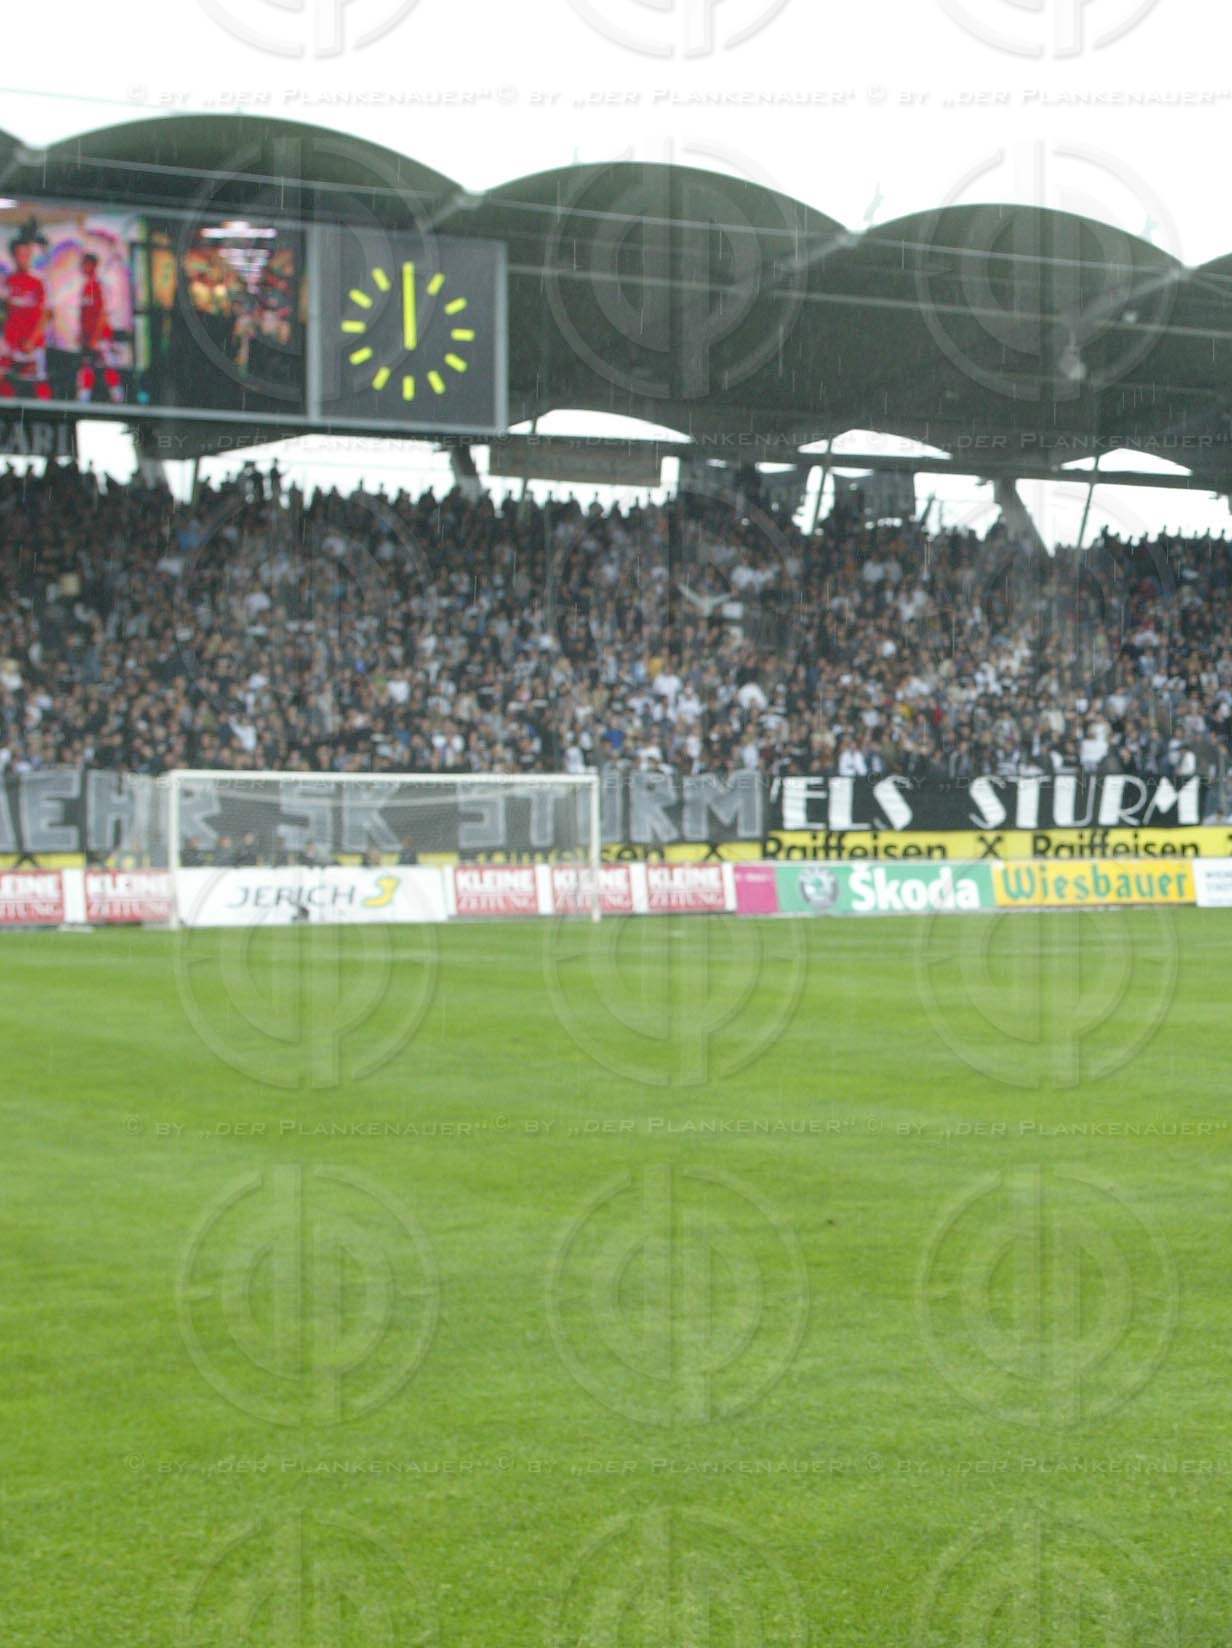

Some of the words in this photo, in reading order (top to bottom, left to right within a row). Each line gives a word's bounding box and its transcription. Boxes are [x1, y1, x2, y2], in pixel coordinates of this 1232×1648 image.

[276, 778, 403, 852] SK
[457, 770, 763, 848] STURM
[969, 775, 1200, 829] STURM
[762, 831, 948, 860] Raiffeisen
[1032, 831, 1200, 858] Raiffeisen
[456, 868, 534, 892] KLEINE
[648, 866, 722, 889] KLEINE
[848, 862, 981, 912] Škoda
[1002, 864, 1188, 900] Wiesbauer
[226, 885, 357, 908] JERICH
